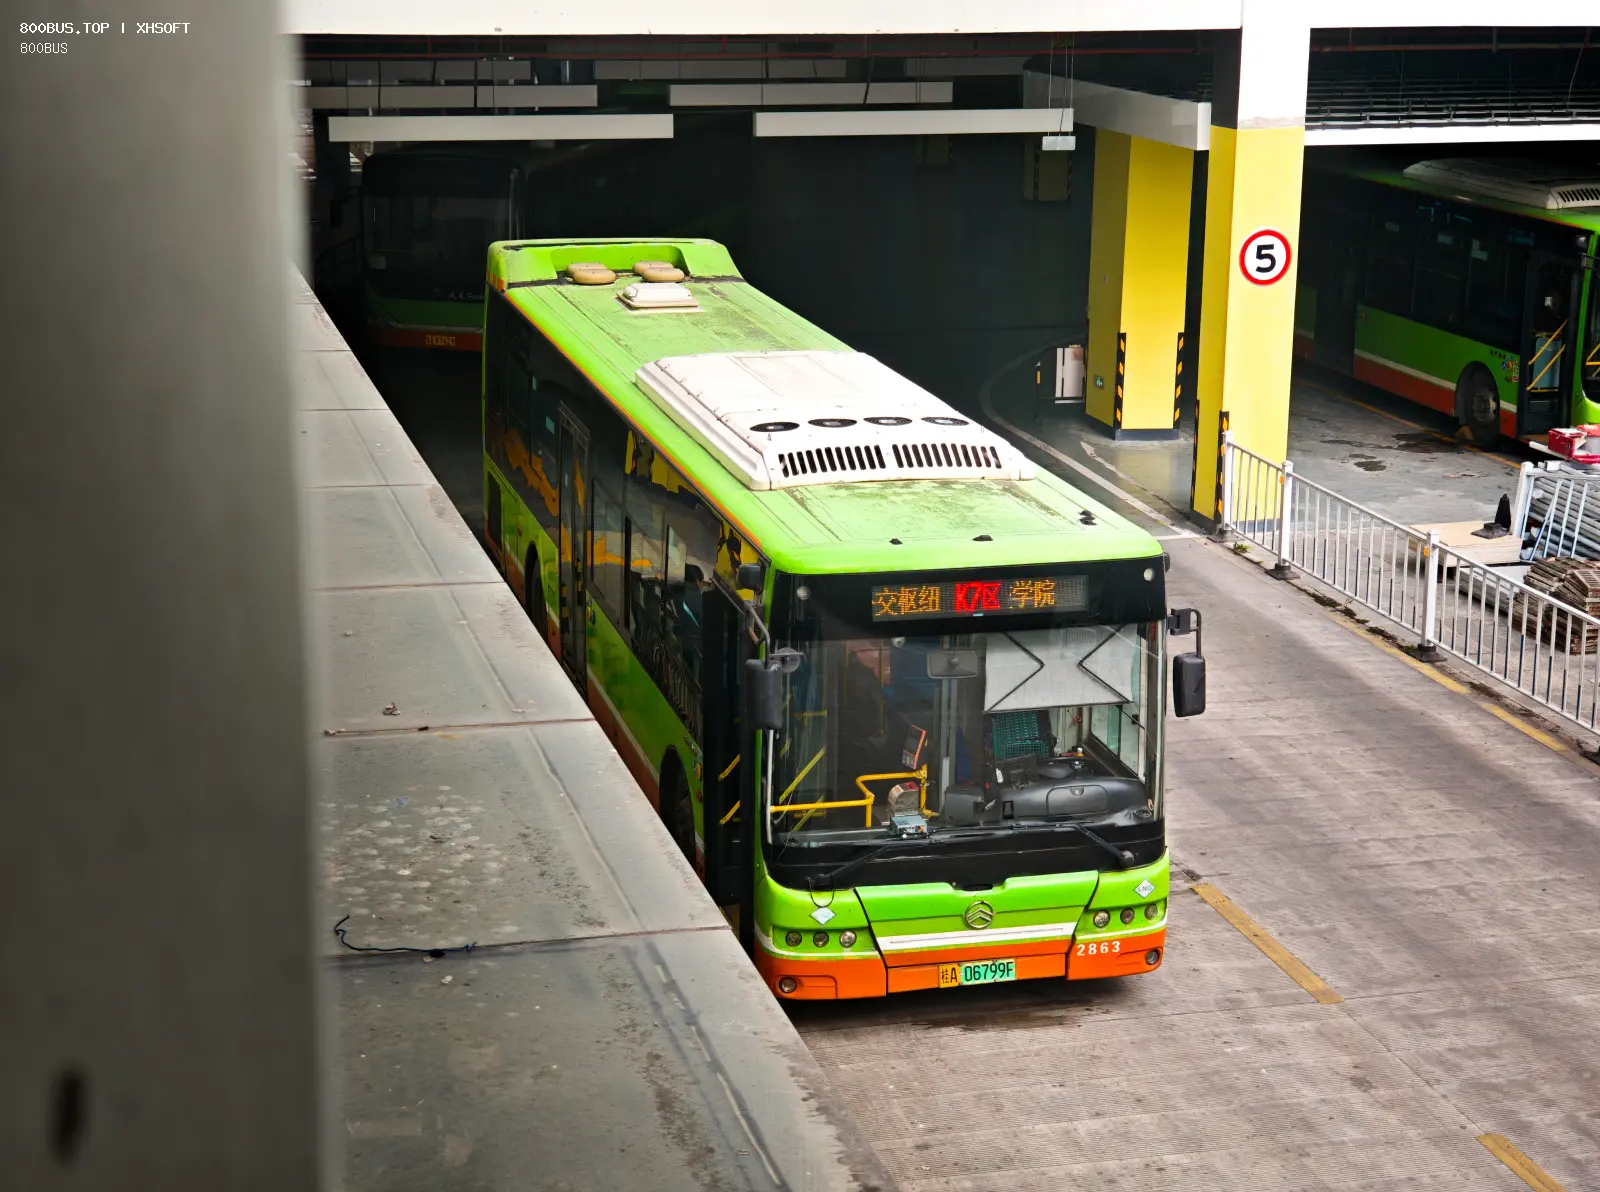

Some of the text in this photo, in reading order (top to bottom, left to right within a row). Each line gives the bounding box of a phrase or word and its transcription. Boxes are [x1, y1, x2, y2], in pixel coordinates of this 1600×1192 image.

[1255, 243, 1277, 273] 5
[1009, 579, 1056, 609] 学院
[1076, 940, 1121, 957] 2863
